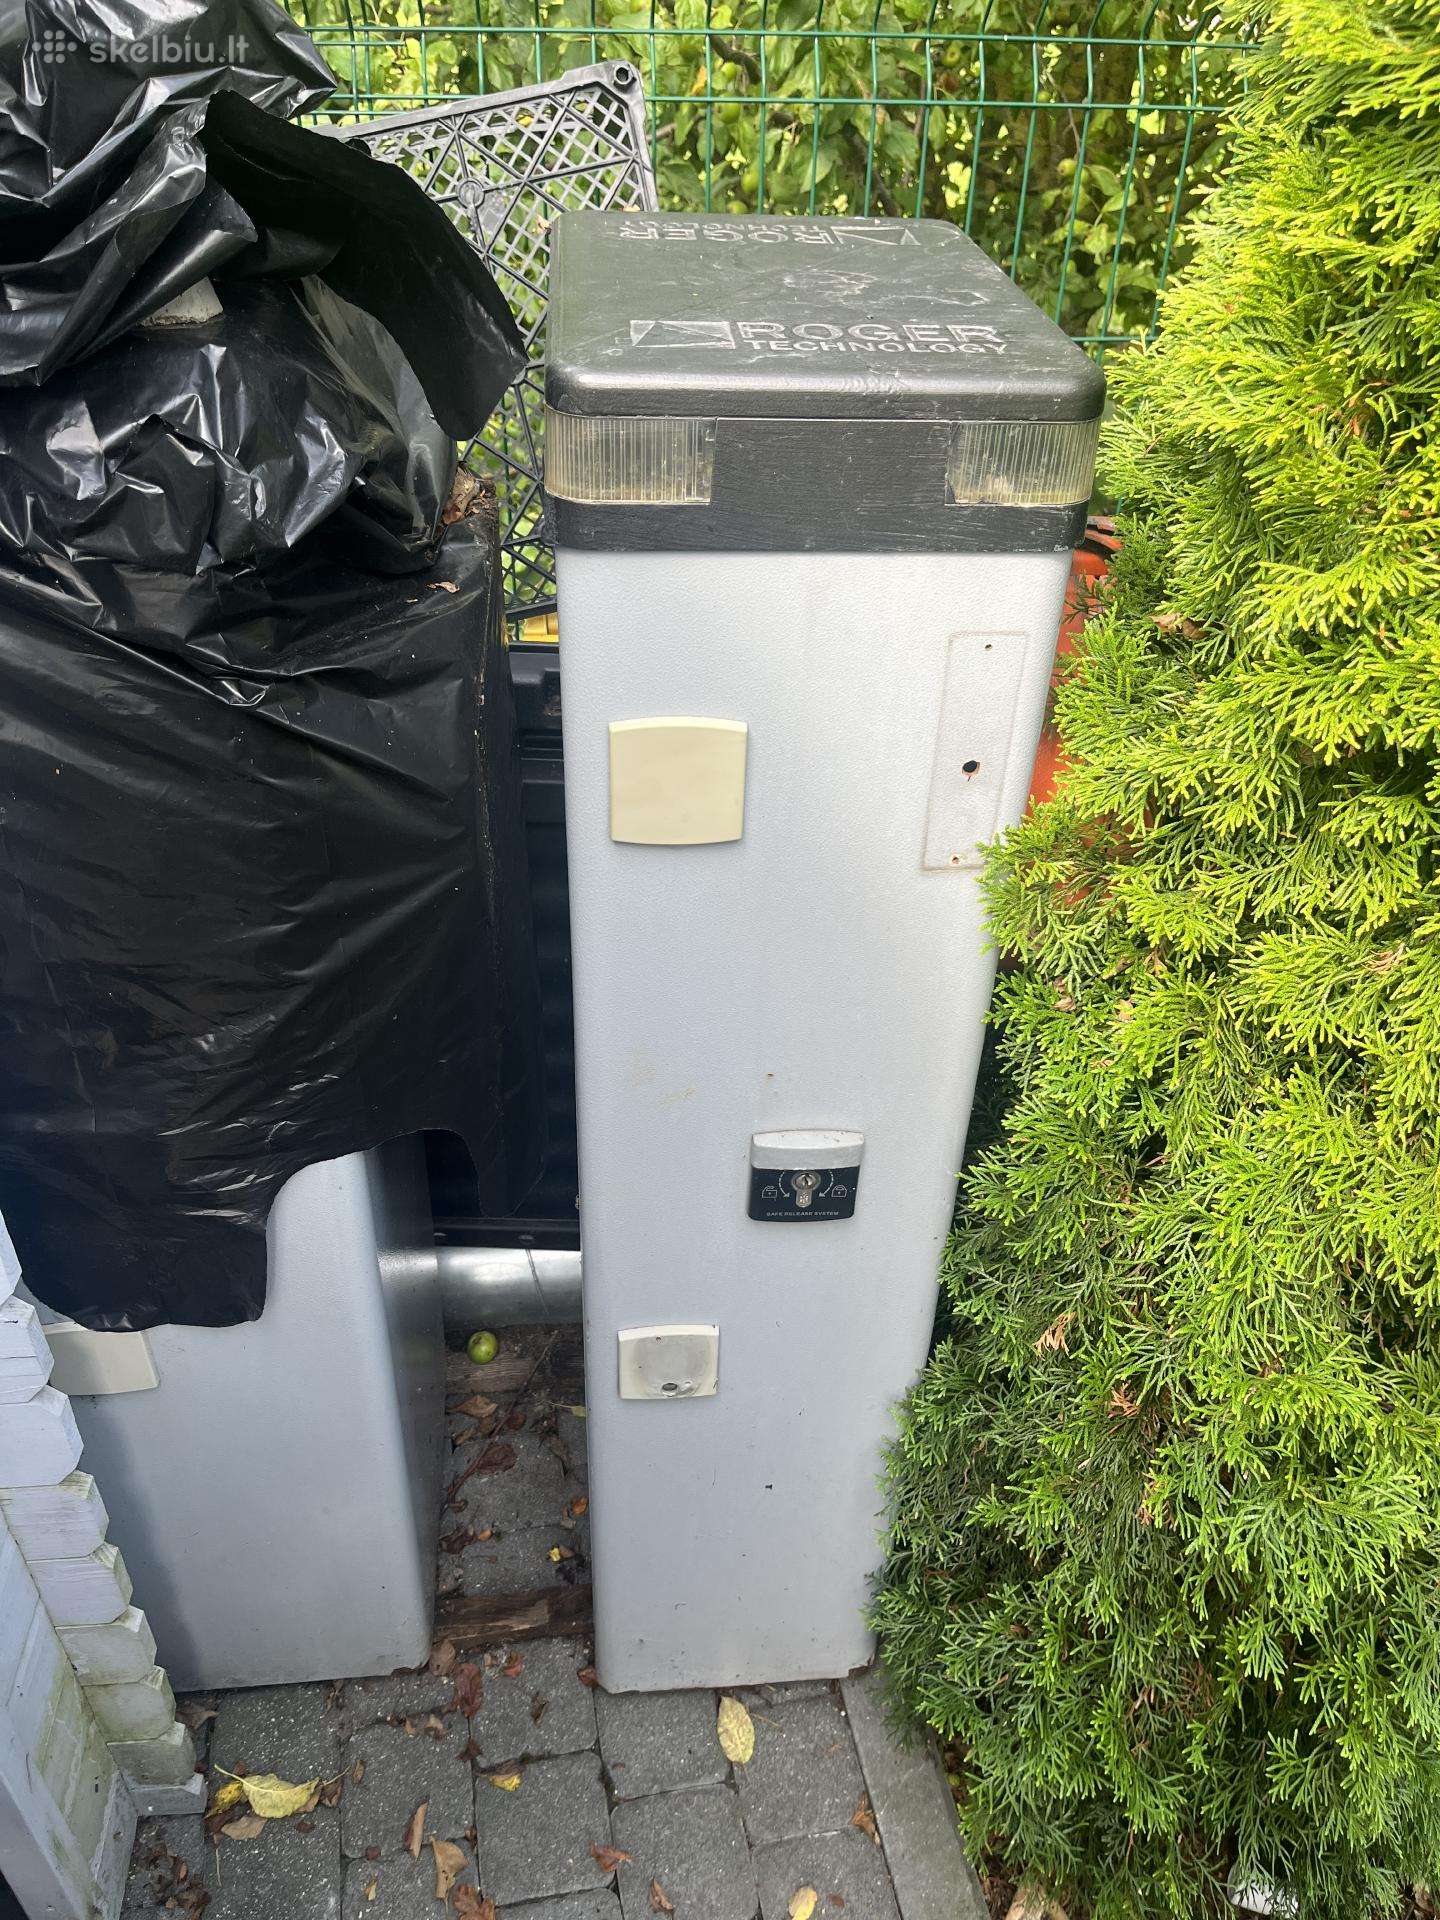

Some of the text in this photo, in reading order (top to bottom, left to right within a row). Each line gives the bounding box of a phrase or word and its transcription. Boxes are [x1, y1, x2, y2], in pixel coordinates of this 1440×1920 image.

[619, 227, 836, 244] ROGER
[737, 321, 1004, 343] ROGER
[744, 340, 1008, 355] TECHNOLOGY
